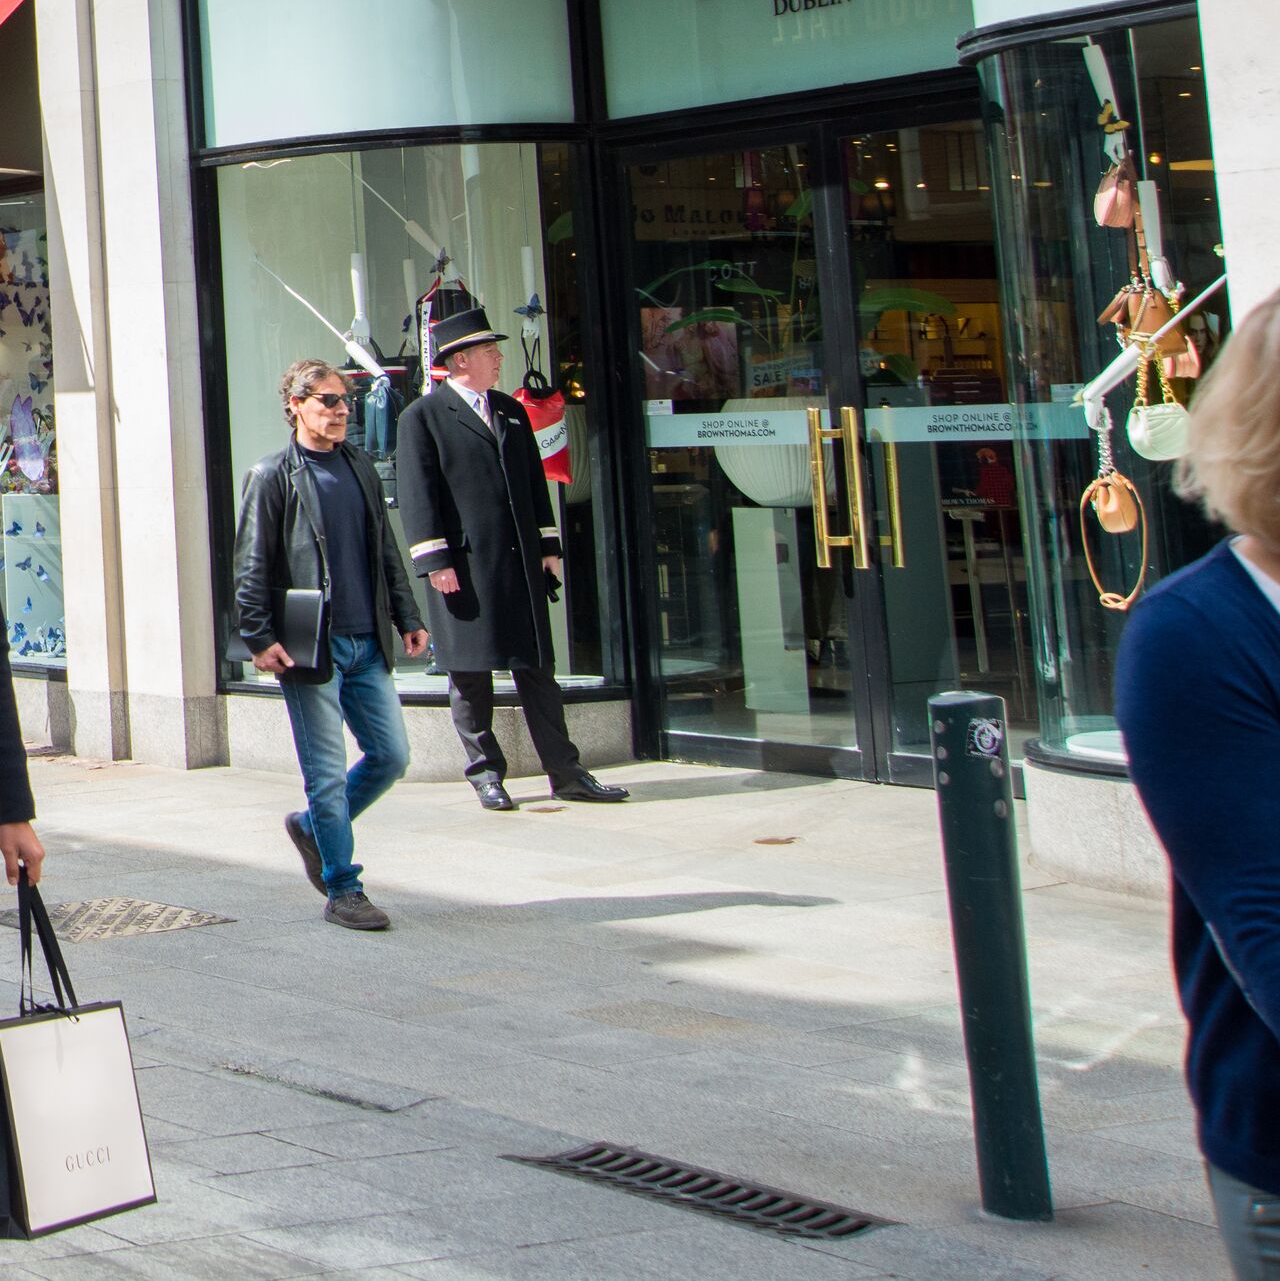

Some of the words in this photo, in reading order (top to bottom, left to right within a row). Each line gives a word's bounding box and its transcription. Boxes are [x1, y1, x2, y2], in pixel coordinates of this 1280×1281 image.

[932, 414, 959, 423] SHOP
[962, 413, 999, 422] ONLINE
[1003, 412, 1011, 422] @
[702, 421, 725, 429] SHOP
[727, 420, 760, 428] ONLINE
[761, 420, 769, 428] @
[927, 423, 1013, 433] BROWNTHOMAS.CO
[697, 429, 776, 438] BROWNTHOMAS.COM
[65, 1145, 111, 1172] GUCCI
